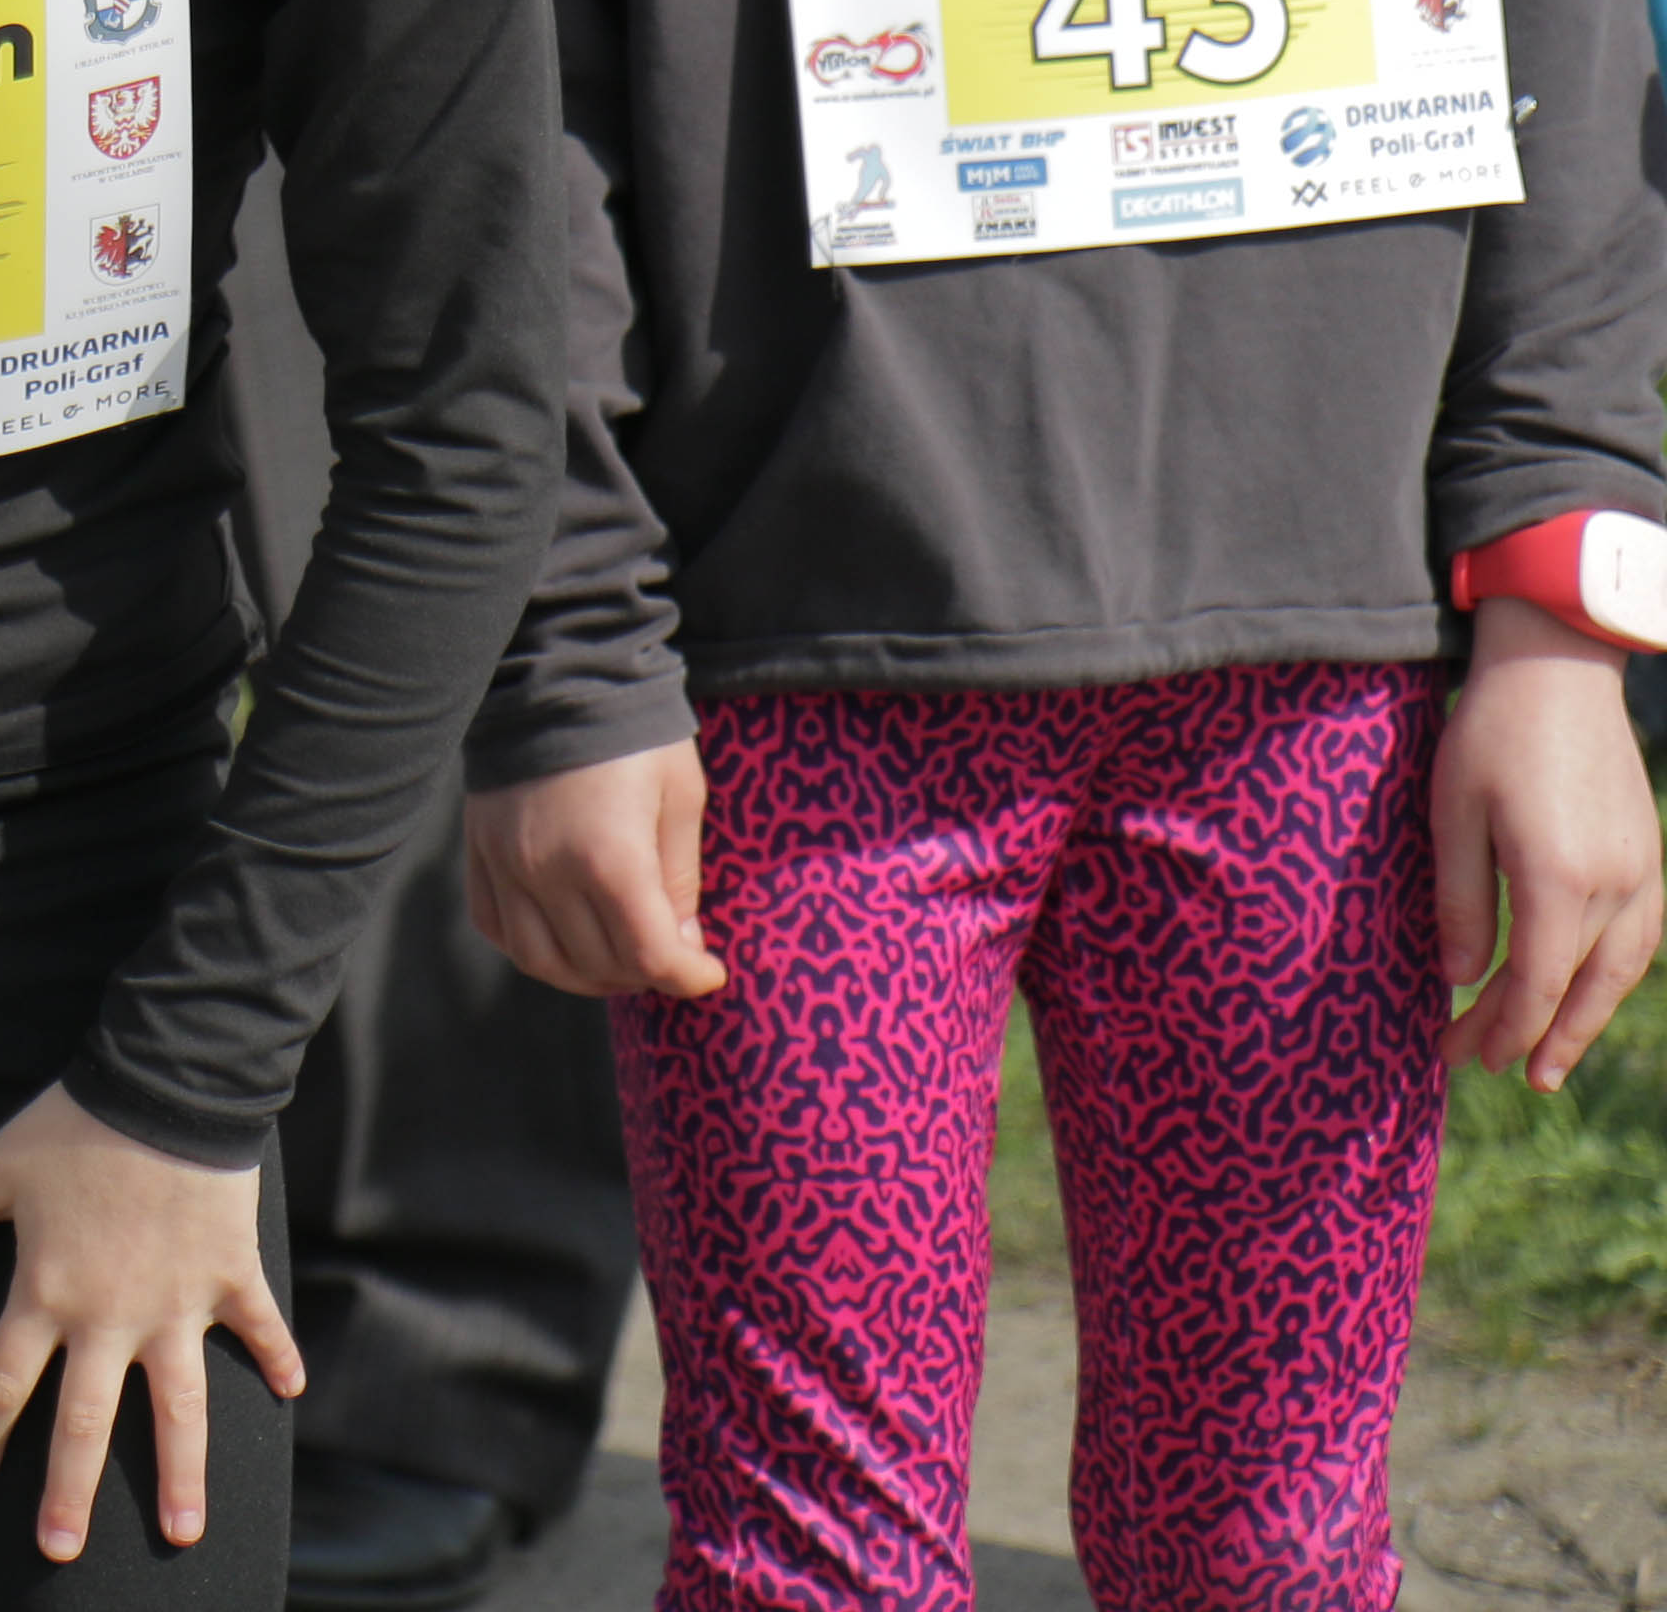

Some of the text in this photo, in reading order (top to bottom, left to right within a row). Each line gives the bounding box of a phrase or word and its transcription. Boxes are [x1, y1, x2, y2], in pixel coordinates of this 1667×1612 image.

[1345, 91, 1495, 128] DRUKARNIA
[1158, 115, 1238, 141] INVEST
[1370, 125, 1477, 157] Poli-Graf
[1340, 177, 1398, 196] FEEL
[1438, 163, 1504, 183] MORE
[1120, 189, 1237, 220] DECATHLON
[0, 321, 170, 376] DRUKARNIA
[24, 353, 145, 400] Poli-Graf
[95, 379, 170, 412] MORE
